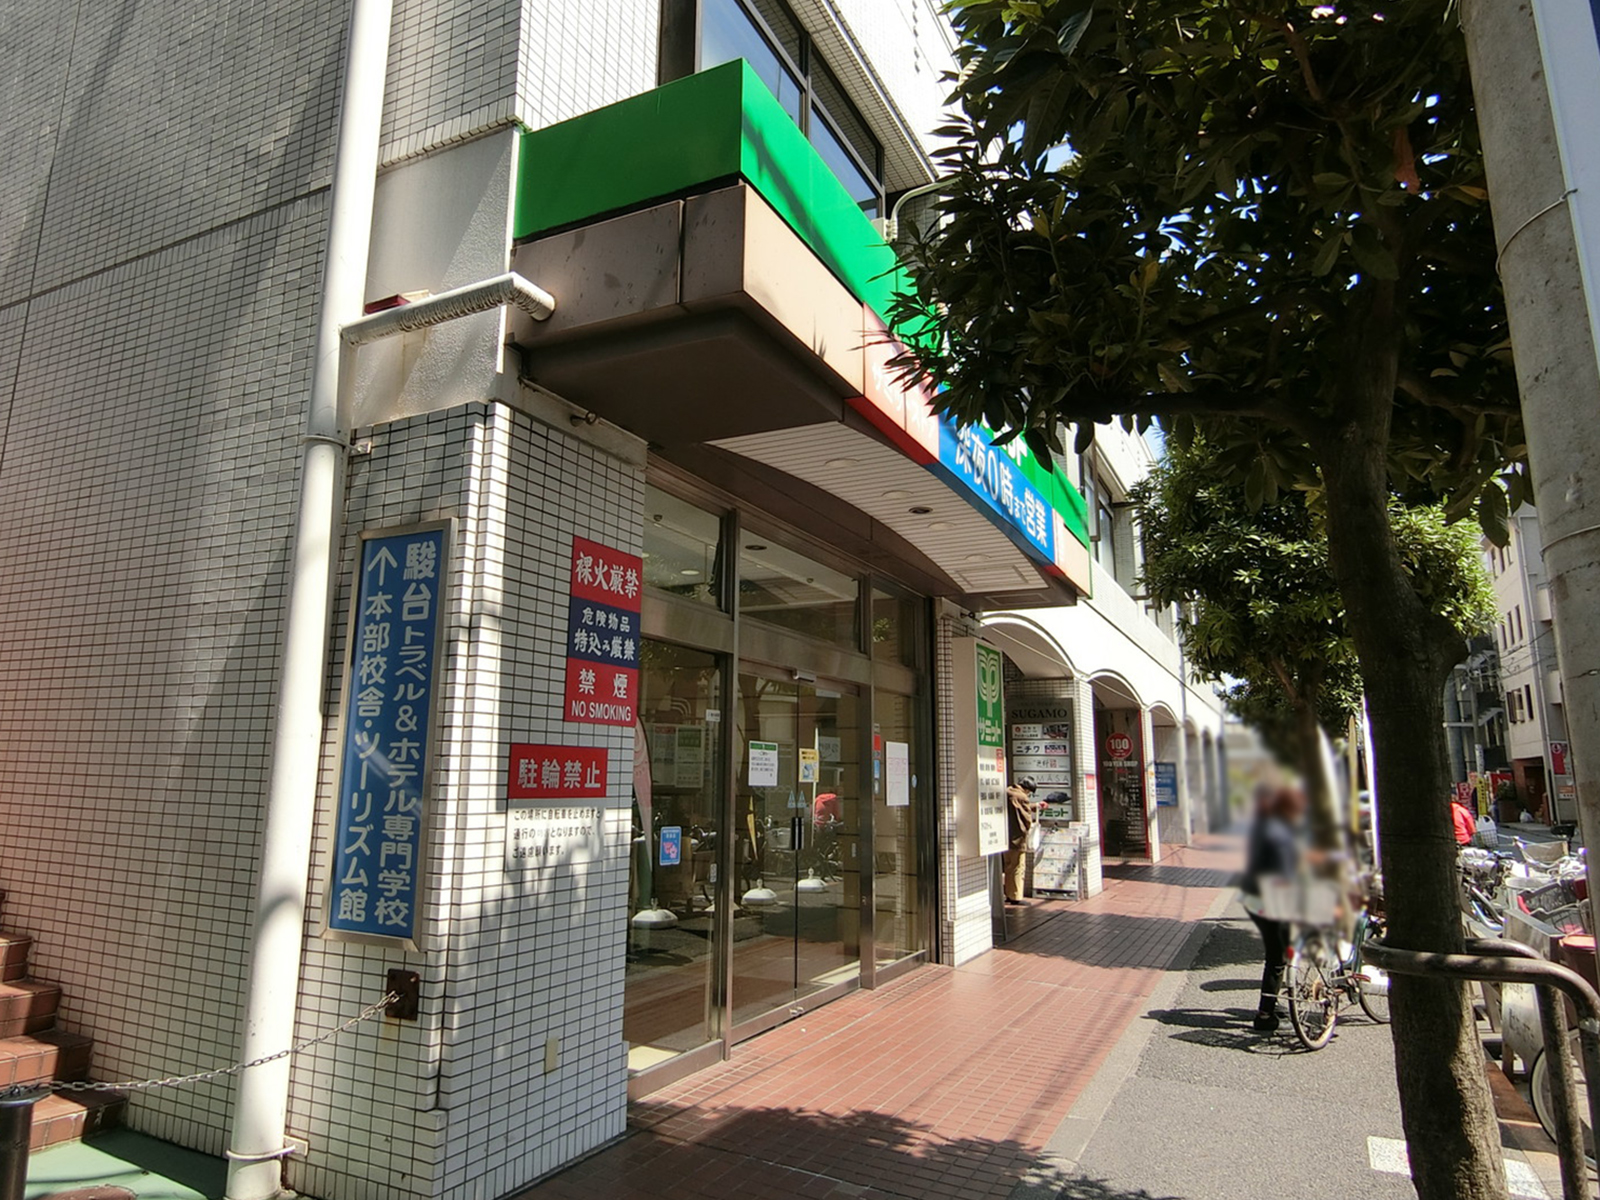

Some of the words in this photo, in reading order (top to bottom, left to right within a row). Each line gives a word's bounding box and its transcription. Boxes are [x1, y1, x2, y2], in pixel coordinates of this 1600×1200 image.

[575, 551, 639, 600] 裸火厳禁
[581, 606, 631, 634] 危険物品
[573, 627, 636, 662] 持込み厳禁
[571, 700, 586, 719] NO
[589, 702, 632, 722] SMOKING
[1011, 708, 1068, 719] SUGAMO
[373, 540, 437, 928] 駿台トラベル&ホテル専門学校
[978, 716, 1002, 743] サミット
[337, 591, 394, 923] 本部校舎・ツーリズム館
[1016, 745, 1041, 754] ニチワ
[1109, 738, 1130, 750] 100
[517, 758, 602, 790] 駐輪禁止
